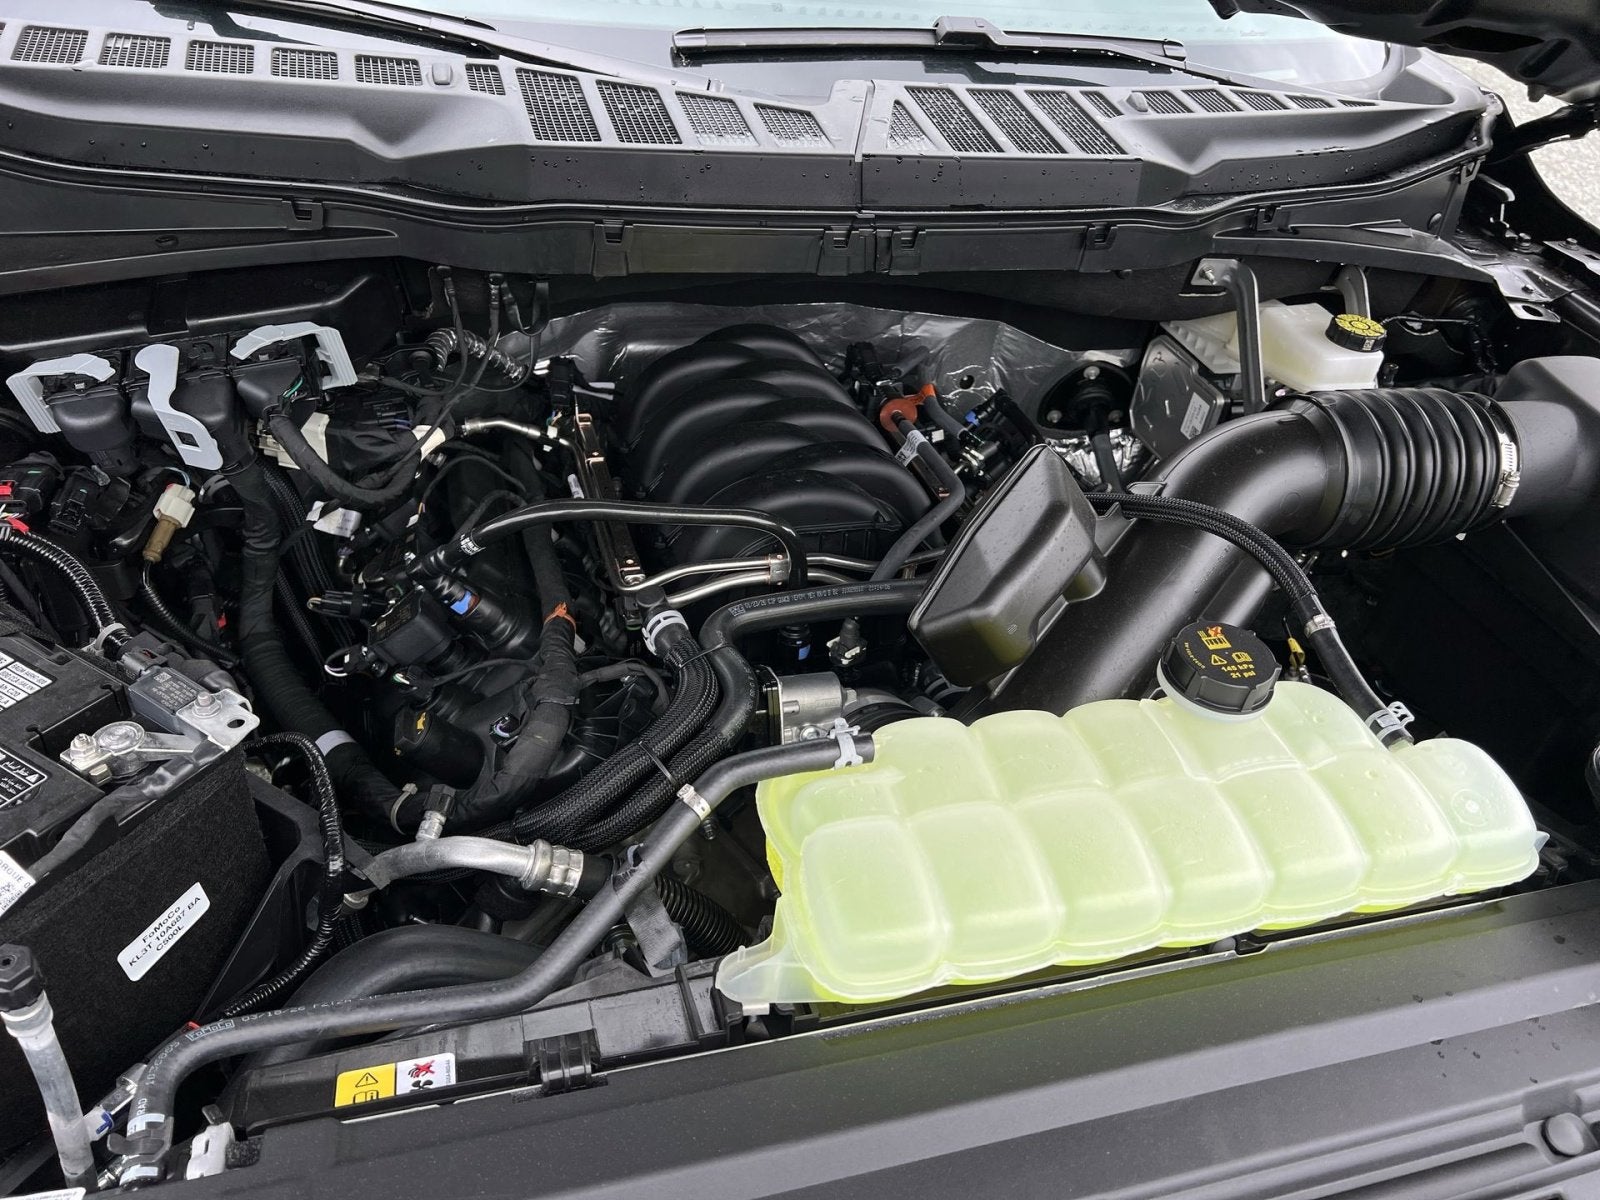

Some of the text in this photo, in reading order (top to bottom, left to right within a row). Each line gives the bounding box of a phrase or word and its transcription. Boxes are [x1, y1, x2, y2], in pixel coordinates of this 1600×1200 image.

[1243, 670, 1257, 678] psi
[128, 896, 201, 967] KL3T 10A687 BA
[142, 905, 181, 944] FoMoCo
[156, 924, 185, 952] C500L
[186, 1020, 235, 1041] FoMoCo
[136, 1097, 148, 1116] RAD
